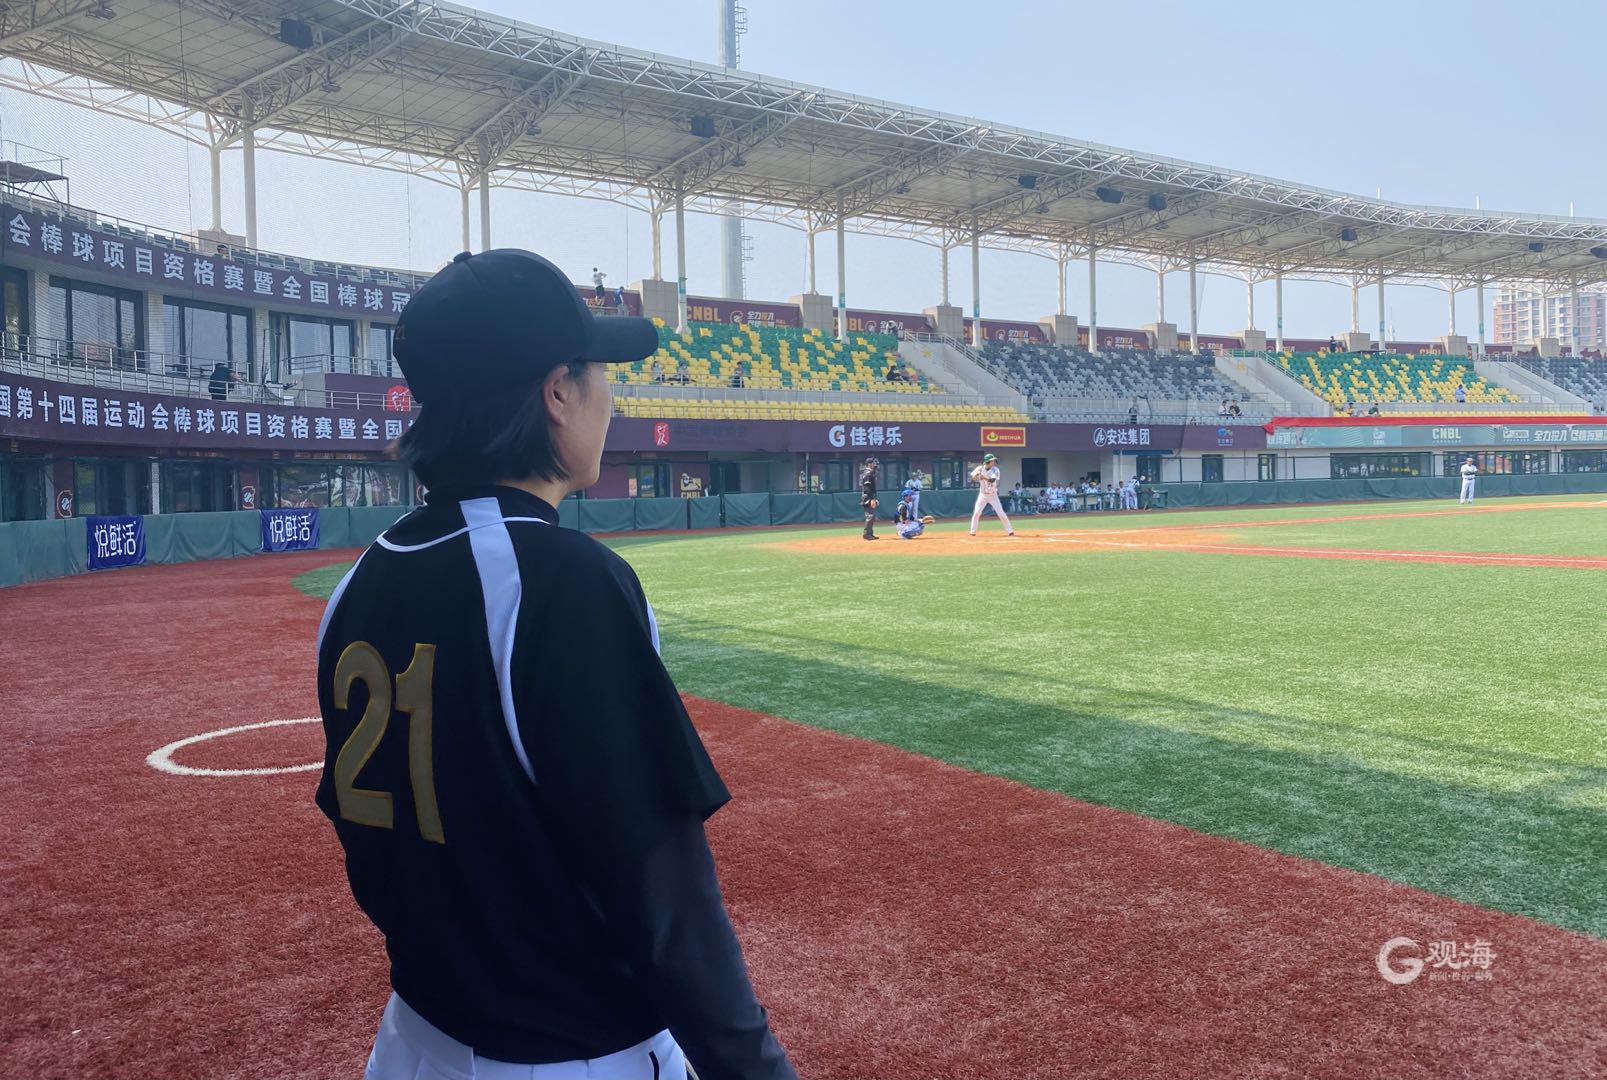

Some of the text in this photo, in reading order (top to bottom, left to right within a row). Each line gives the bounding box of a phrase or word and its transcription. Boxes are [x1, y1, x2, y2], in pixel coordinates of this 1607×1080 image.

[9, 213, 411, 313] 会棒球项目资格赛暨全国棒球冠
[0, 385, 414, 441] 国第十四届运动会棒球项目资格赛暨全国
[849, 426, 902, 447] 佳得乐
[1107, 428, 1150, 445] 安达集团
[1432, 428, 1461, 440] CNBL
[94, 522, 137, 558] 悦鲜活
[269, 513, 311, 543] 悦鲜活
[334, 640, 446, 845] 21
